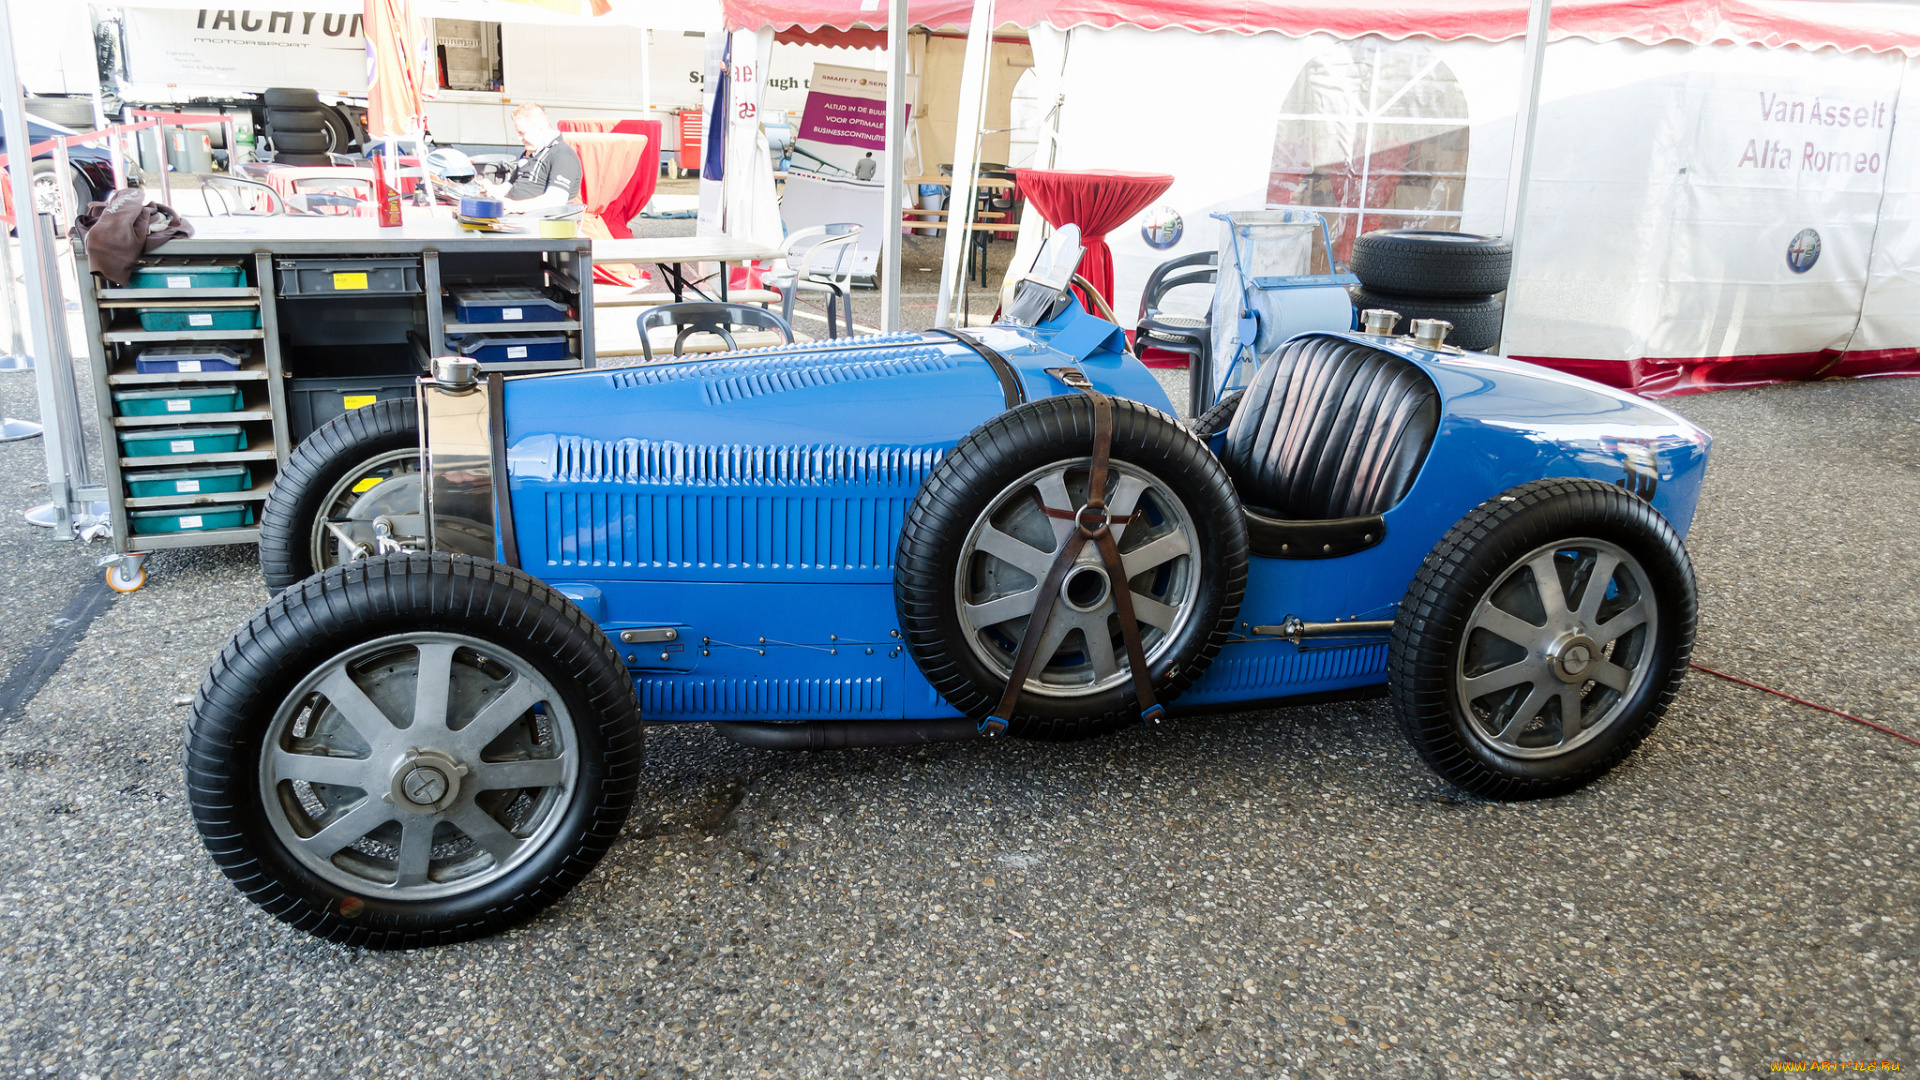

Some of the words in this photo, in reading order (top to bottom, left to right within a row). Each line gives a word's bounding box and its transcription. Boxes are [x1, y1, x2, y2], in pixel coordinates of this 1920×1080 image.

[767, 77, 799, 90] ugh
[804, 78, 810, 89] t
[822, 75, 848, 83] SMART
[824, 102, 847, 112] ALTIJD
[857, 106, 868, 114] DE
[868, 108, 886, 116] BUUR
[1759, 91, 1805, 124] Van
[1809, 97, 1885, 129] Asselt
[825, 115, 847, 124] VOOR
[848, 118, 884, 129] OPTIMALE
[1737, 139, 1792, 170] Alfa
[1802, 141, 1881, 174] Romeo
